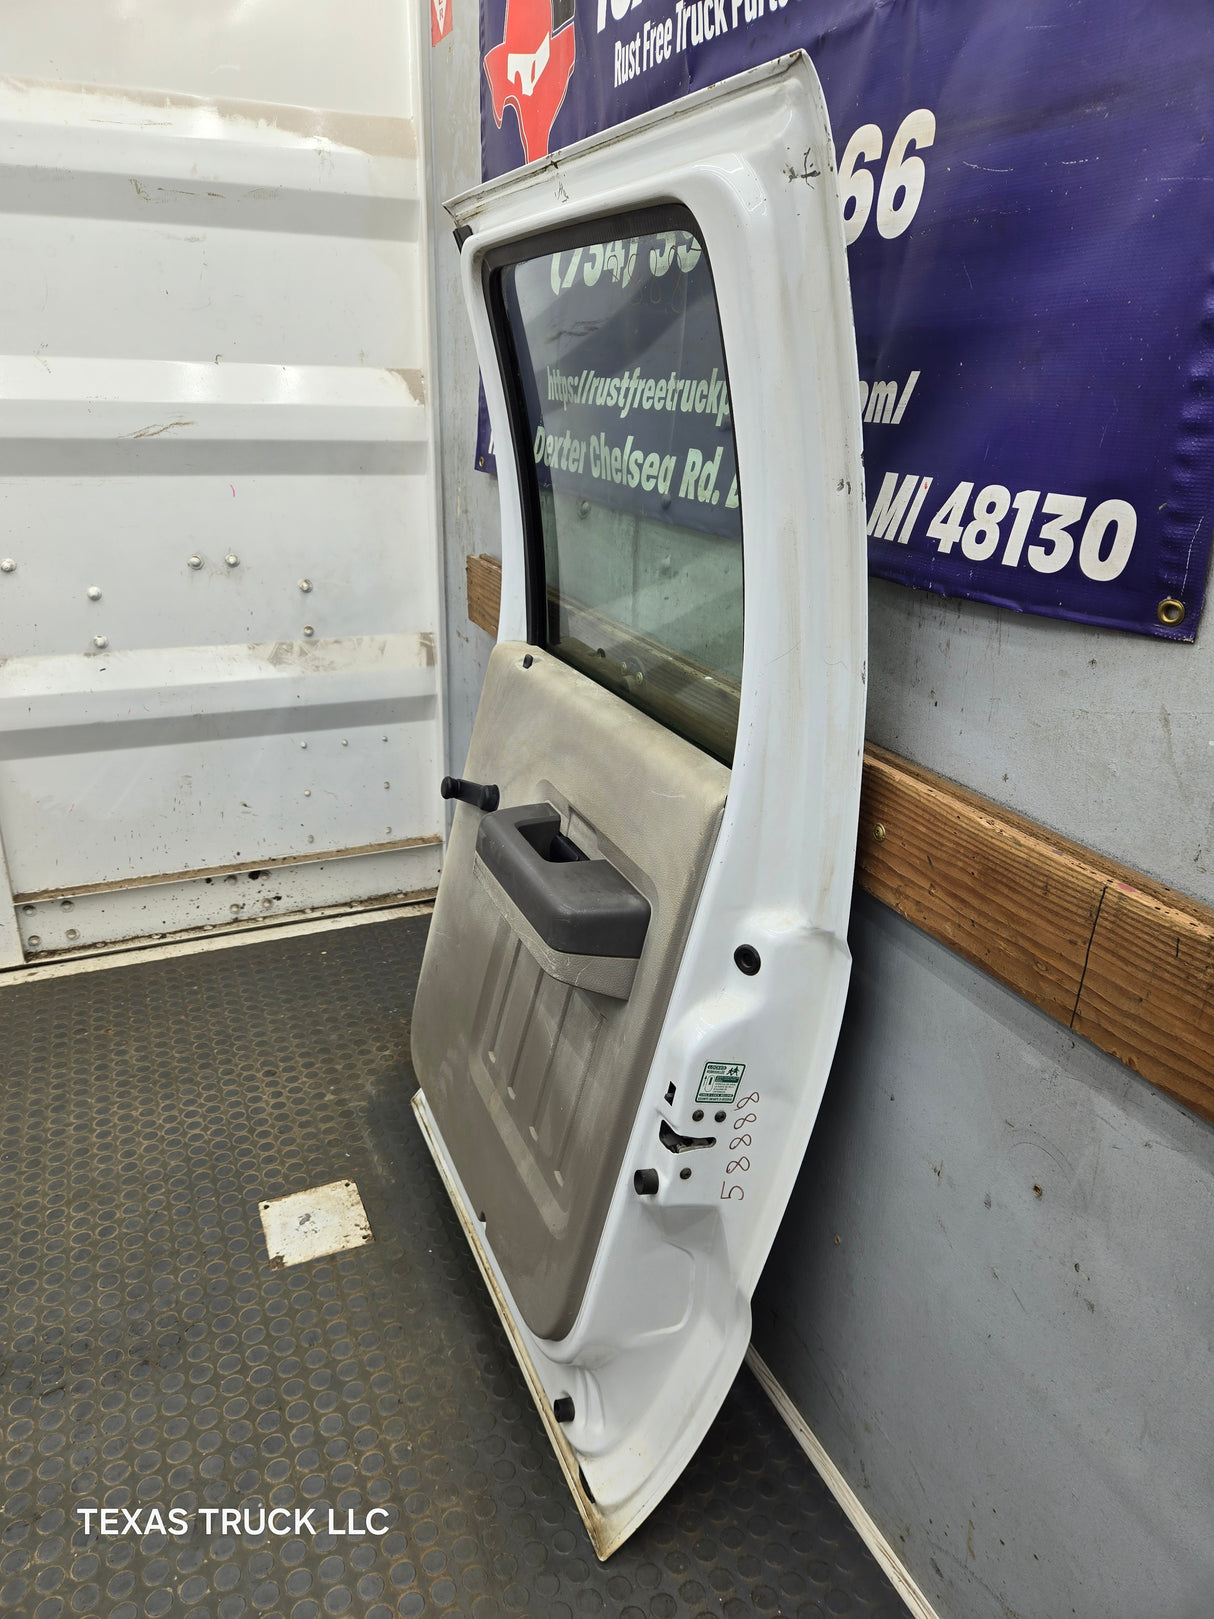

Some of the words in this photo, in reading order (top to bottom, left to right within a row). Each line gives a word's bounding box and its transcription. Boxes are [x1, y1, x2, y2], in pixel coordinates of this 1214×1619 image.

[613, 30, 642, 88] Rust
[642, 16, 673, 72] Free
[676, 0, 729, 54] Truck
[838, 108, 936, 246] 66
[533, 425, 587, 474] Dexter
[589, 432, 677, 494] Chelsea
[679, 446, 724, 505] Rd.
[867, 471, 934, 545] MI
[926, 481, 1138, 582] 48130
